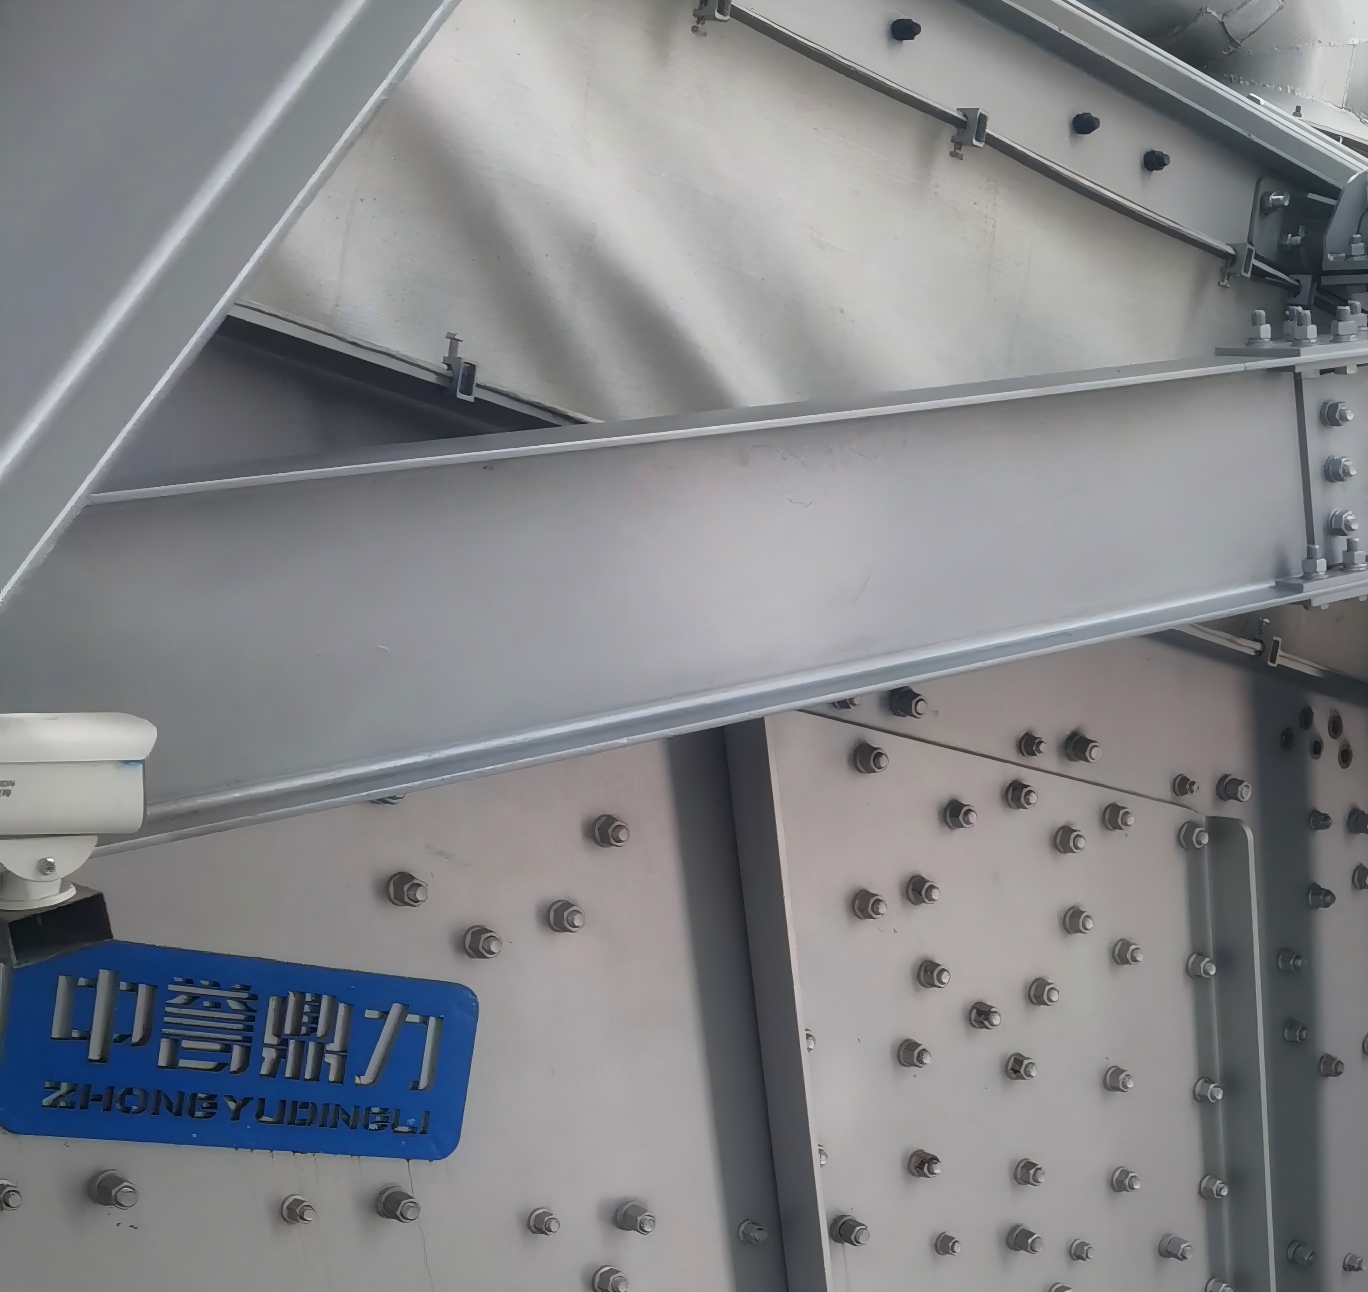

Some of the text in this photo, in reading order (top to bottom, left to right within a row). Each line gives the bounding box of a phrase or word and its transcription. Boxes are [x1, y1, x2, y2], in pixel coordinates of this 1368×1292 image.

[51, 968, 444, 1091] 中誉鼎力
[41, 1080, 431, 1135] ZHONGYUDINGLI
